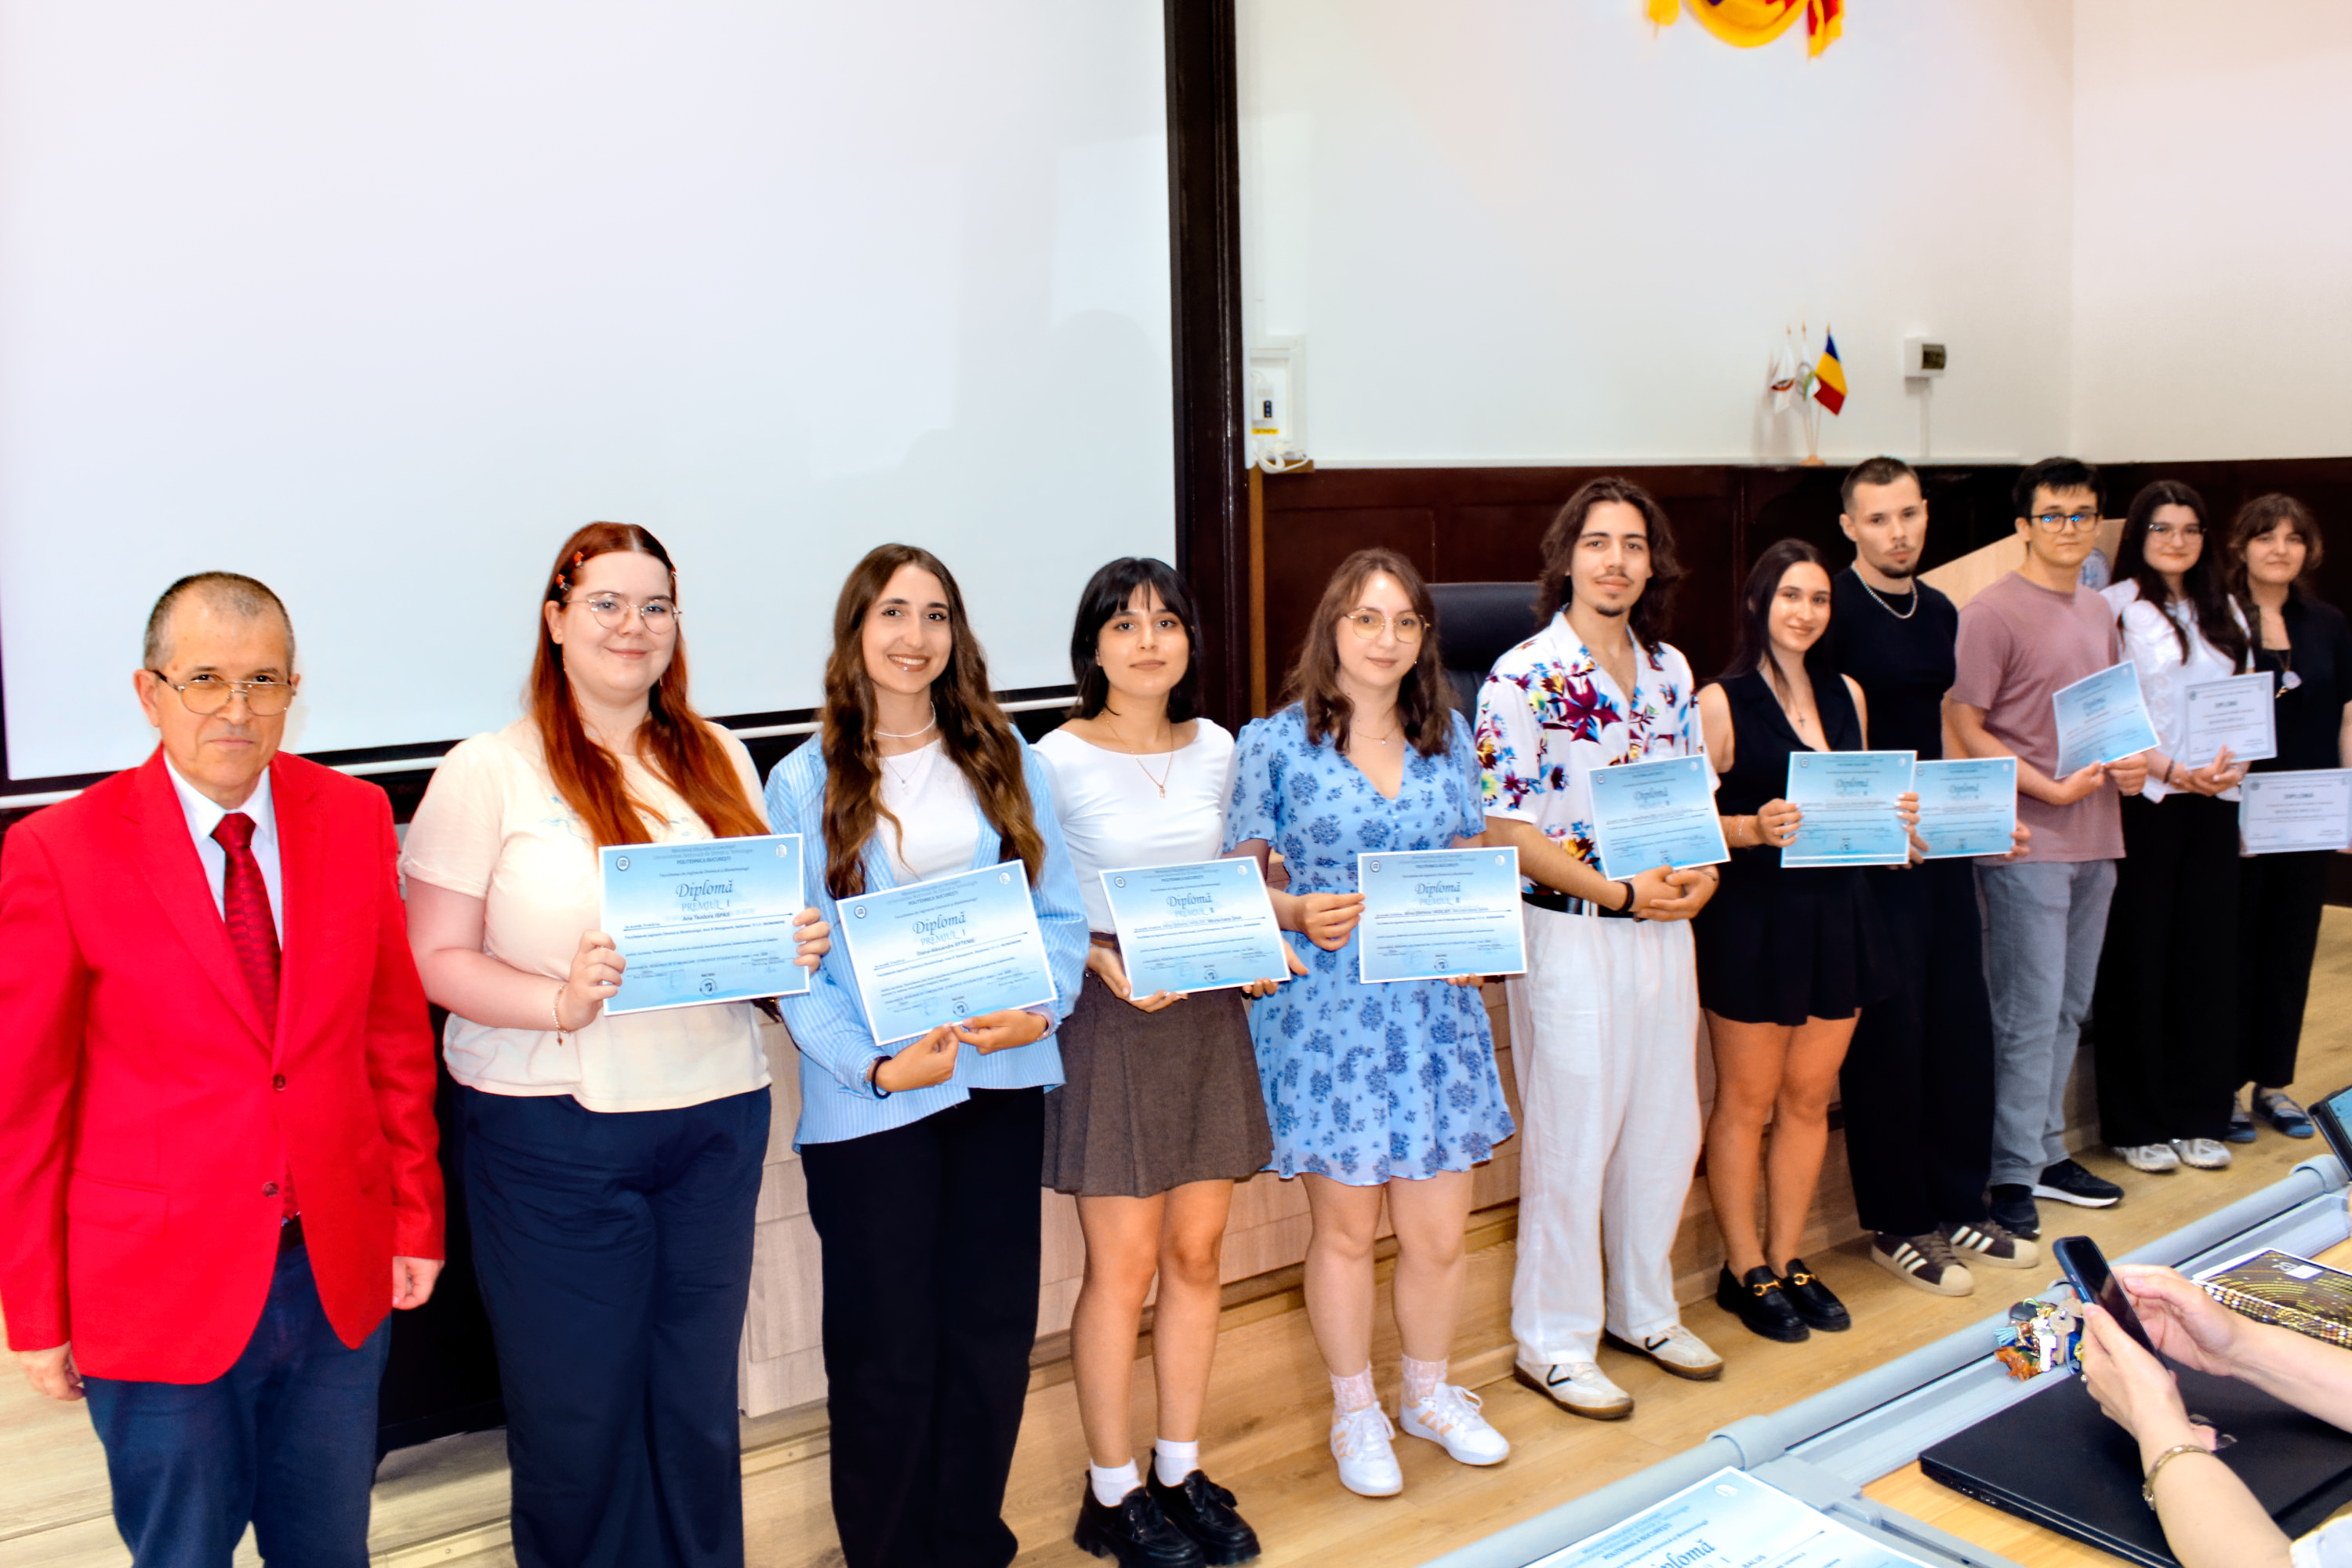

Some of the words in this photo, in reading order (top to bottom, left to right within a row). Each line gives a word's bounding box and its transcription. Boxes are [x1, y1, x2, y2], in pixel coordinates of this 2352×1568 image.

[676, 880, 732, 901] Diplomă
[1415, 881, 1461, 897] Diplomă
[681, 900, 724, 911] PREMIUL
[1167, 893, 1212, 909] Diplomă
[913, 912, 966, 935] Diplomă
